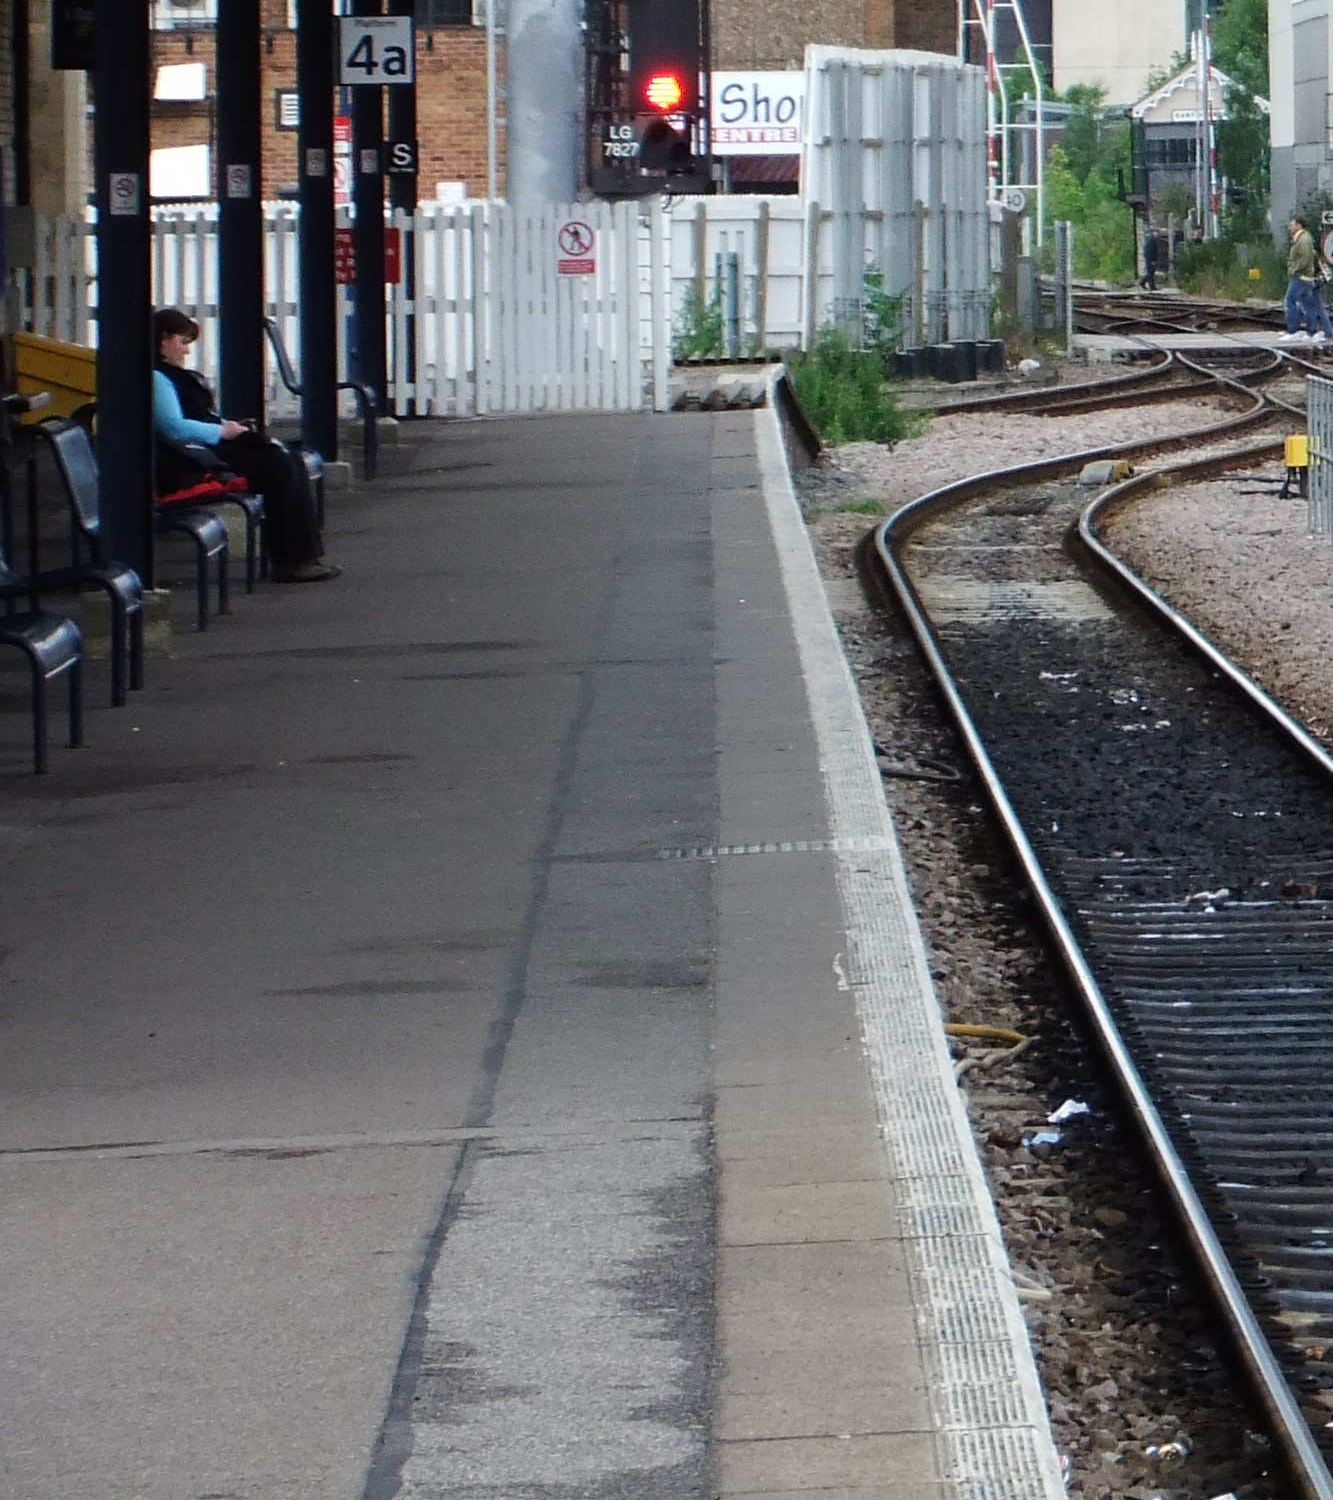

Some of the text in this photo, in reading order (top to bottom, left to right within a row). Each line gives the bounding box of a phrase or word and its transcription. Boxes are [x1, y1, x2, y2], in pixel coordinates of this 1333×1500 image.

[346, 34, 407, 76] 4a
[609, 125, 632, 140] LG
[712, 127, 797, 143] ENTRE
[392, 143, 412, 166] S
[603, 142, 640, 157] 7827
